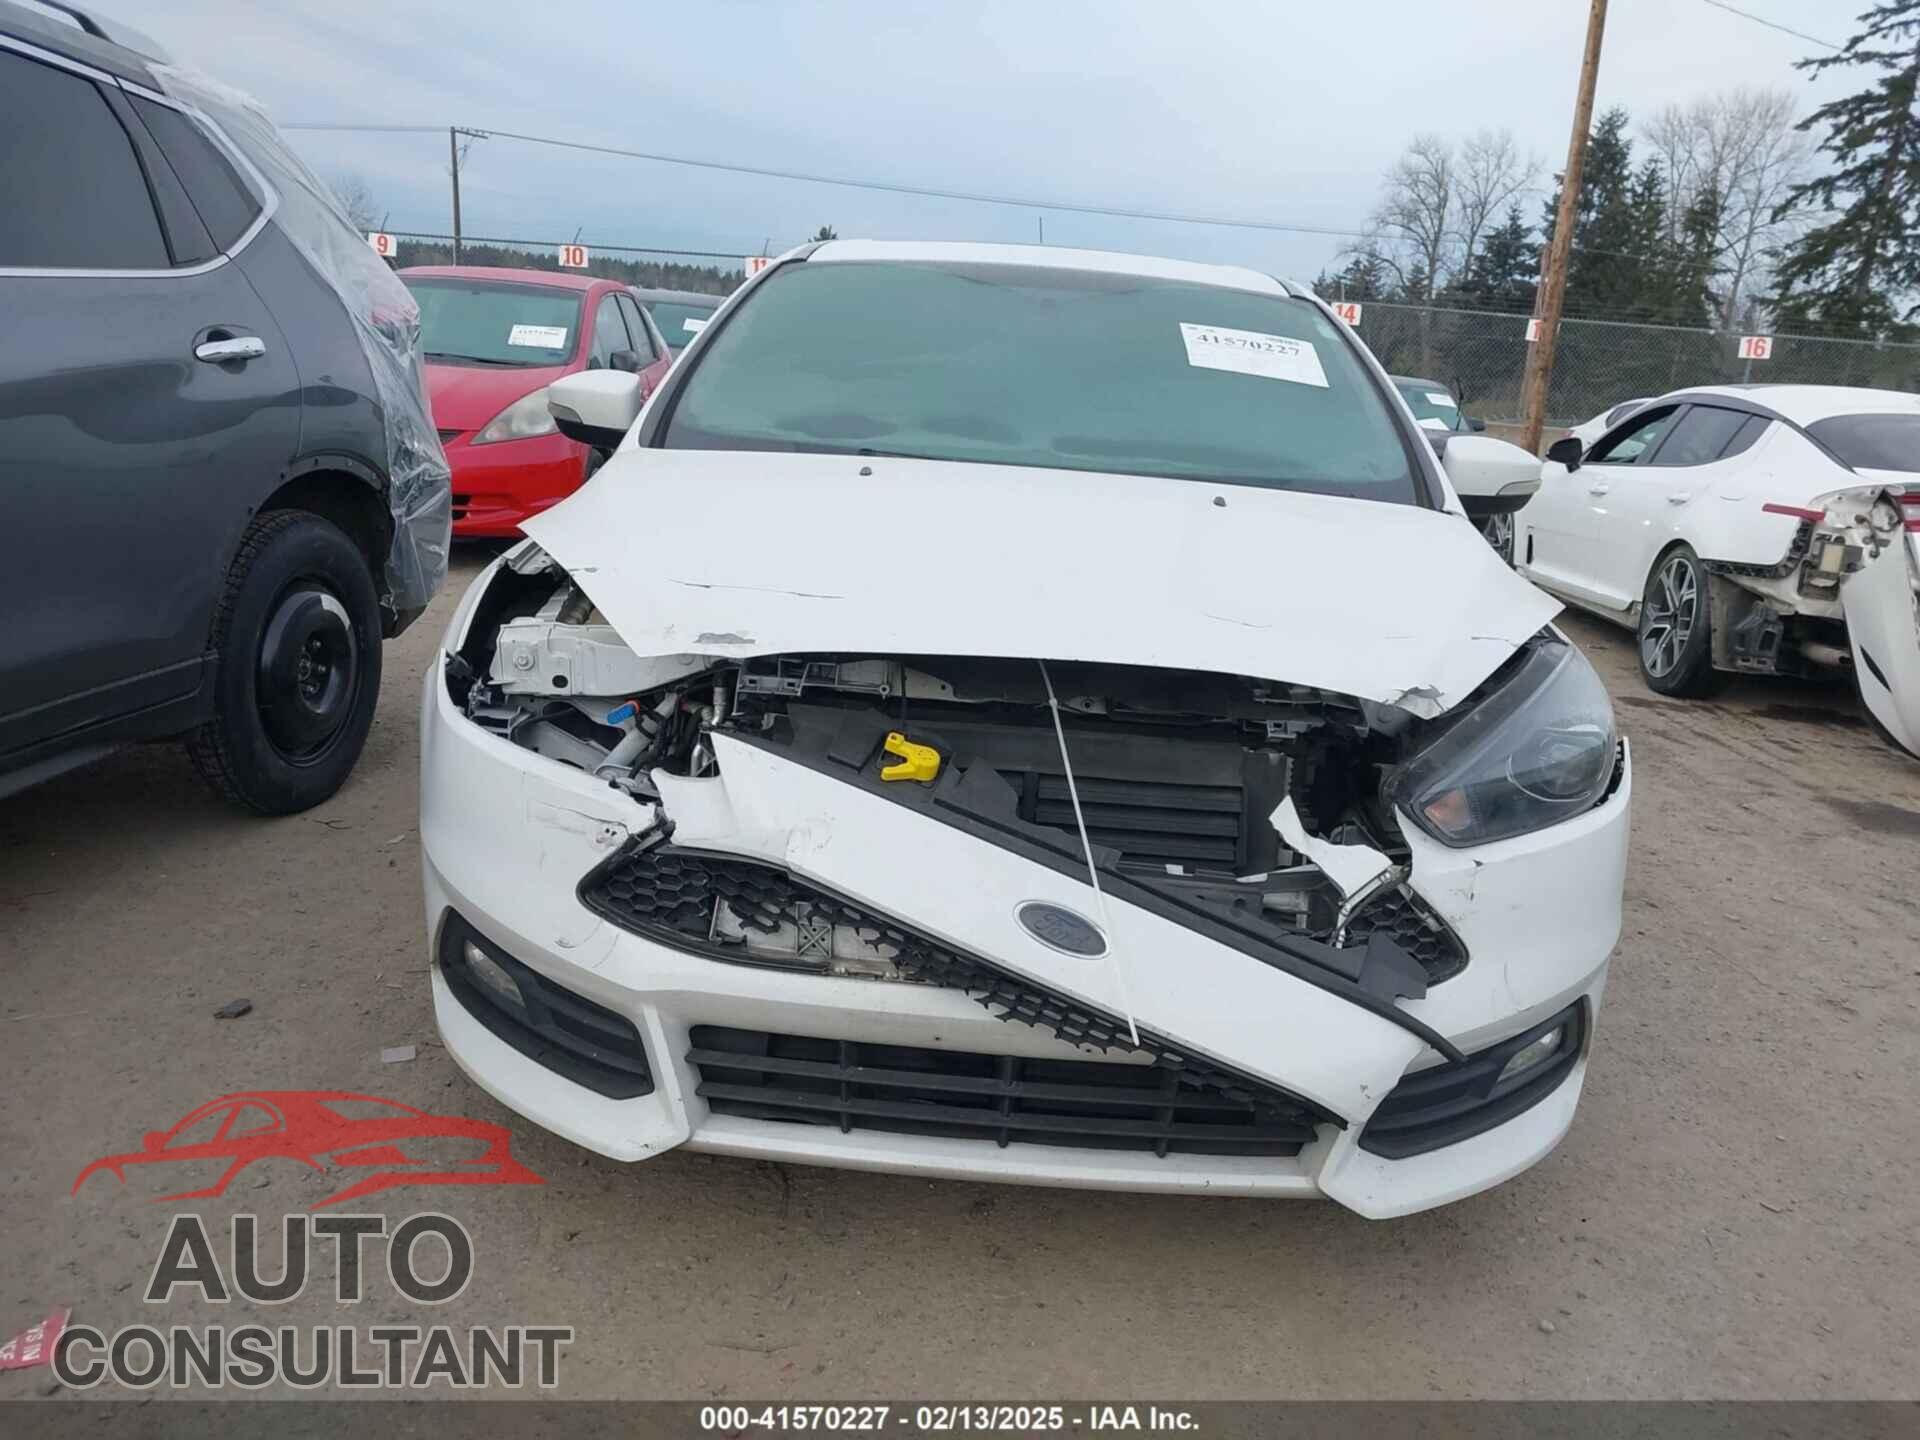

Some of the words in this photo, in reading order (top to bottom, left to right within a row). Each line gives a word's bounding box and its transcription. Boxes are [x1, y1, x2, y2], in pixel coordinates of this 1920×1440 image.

[377, 235, 388, 254] 9
[564, 246, 584, 266] 10
[1336, 304, 1356, 323] 14
[1197, 333, 1300, 357] 41570227
[1745, 338, 1766, 357] 16
